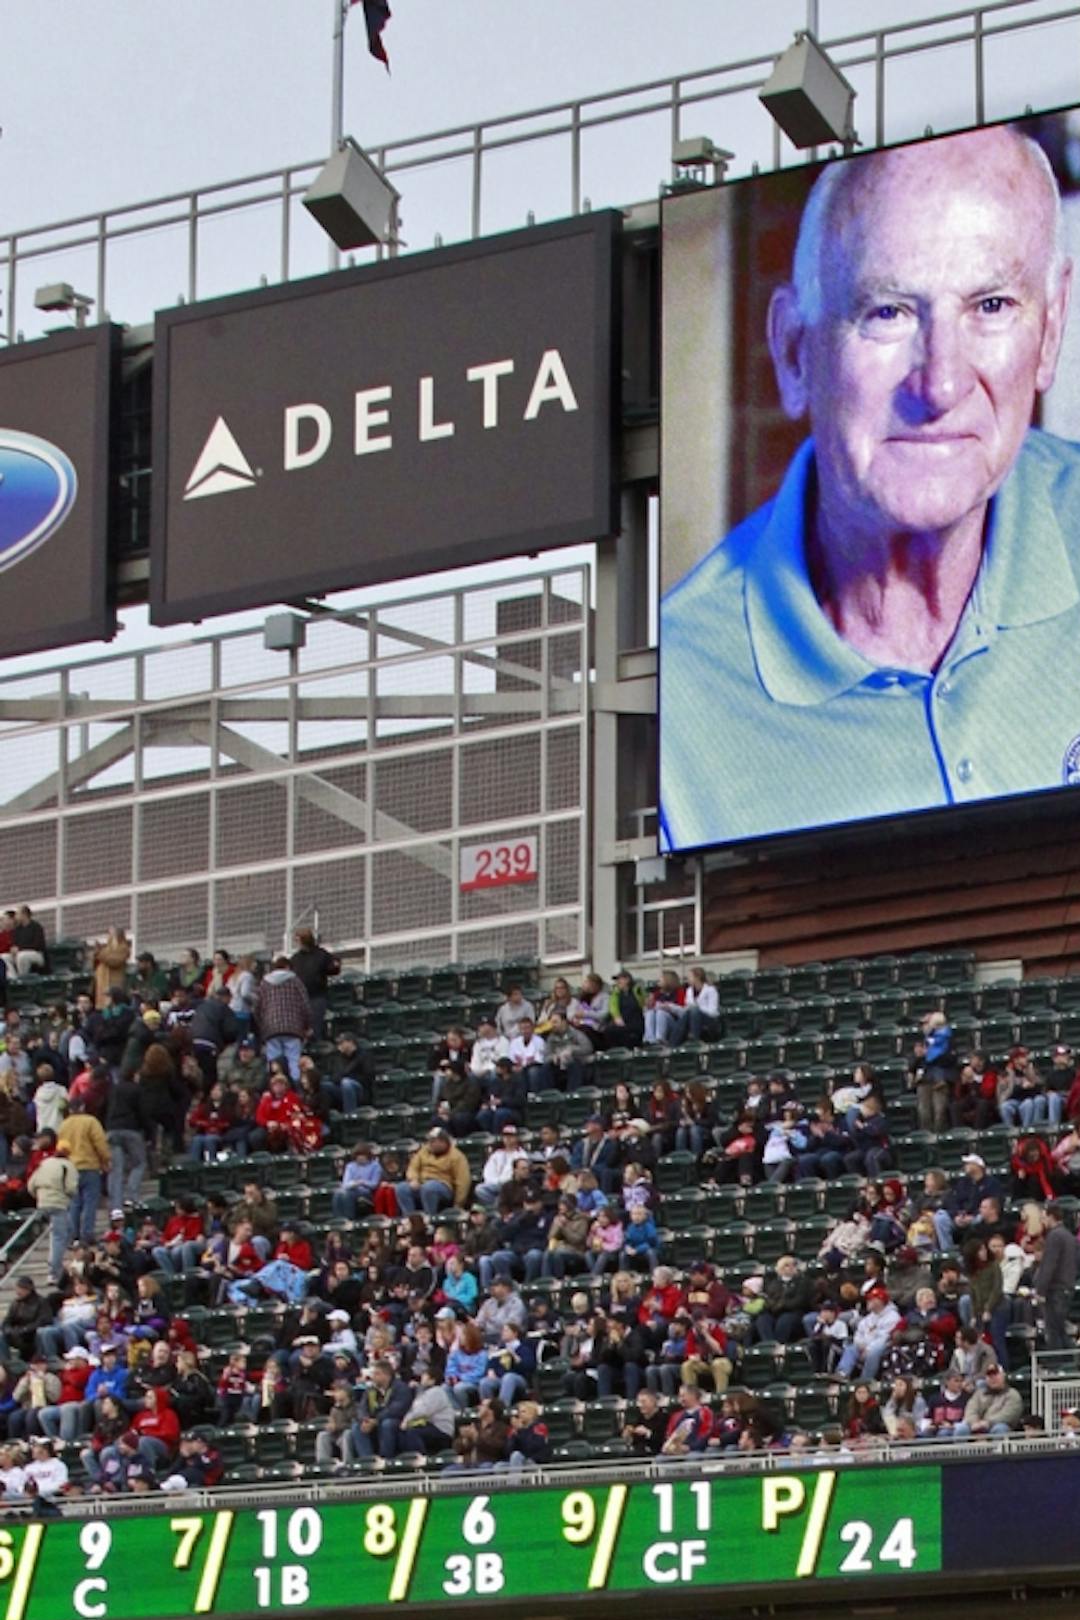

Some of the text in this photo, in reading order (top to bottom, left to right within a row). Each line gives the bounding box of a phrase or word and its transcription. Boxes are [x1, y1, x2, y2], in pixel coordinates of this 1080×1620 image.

[284, 349, 579, 471] DELTA
[475, 843, 531, 883] 239
[462, 1496, 496, 1545] 6
[652, 1481, 711, 1533] 11
[79, 1521, 112, 1569] 9
[257, 1507, 322, 1558] 10
[839, 1518, 917, 1572] 24
[442, 1553, 504, 1595] 3B
[643, 1540, 707, 1582] CF
[73, 1577, 107, 1618] C
[253, 1565, 309, 1606] 1B
